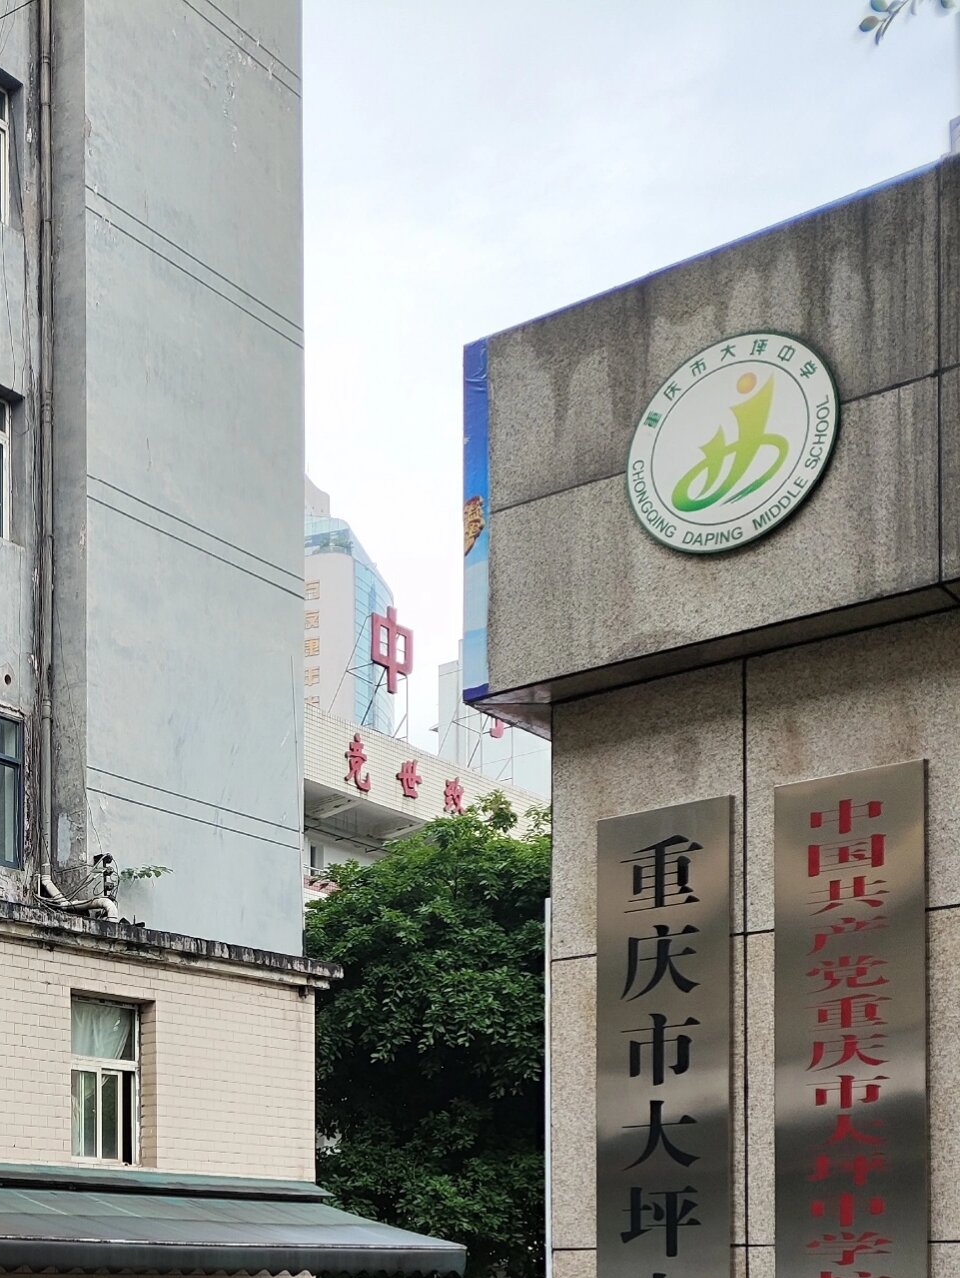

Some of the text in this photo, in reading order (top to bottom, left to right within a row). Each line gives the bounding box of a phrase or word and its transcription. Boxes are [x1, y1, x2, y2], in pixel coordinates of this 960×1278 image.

[632, 395, 830, 546] CHONGQING DAPING MIDDLE SCHOOL
